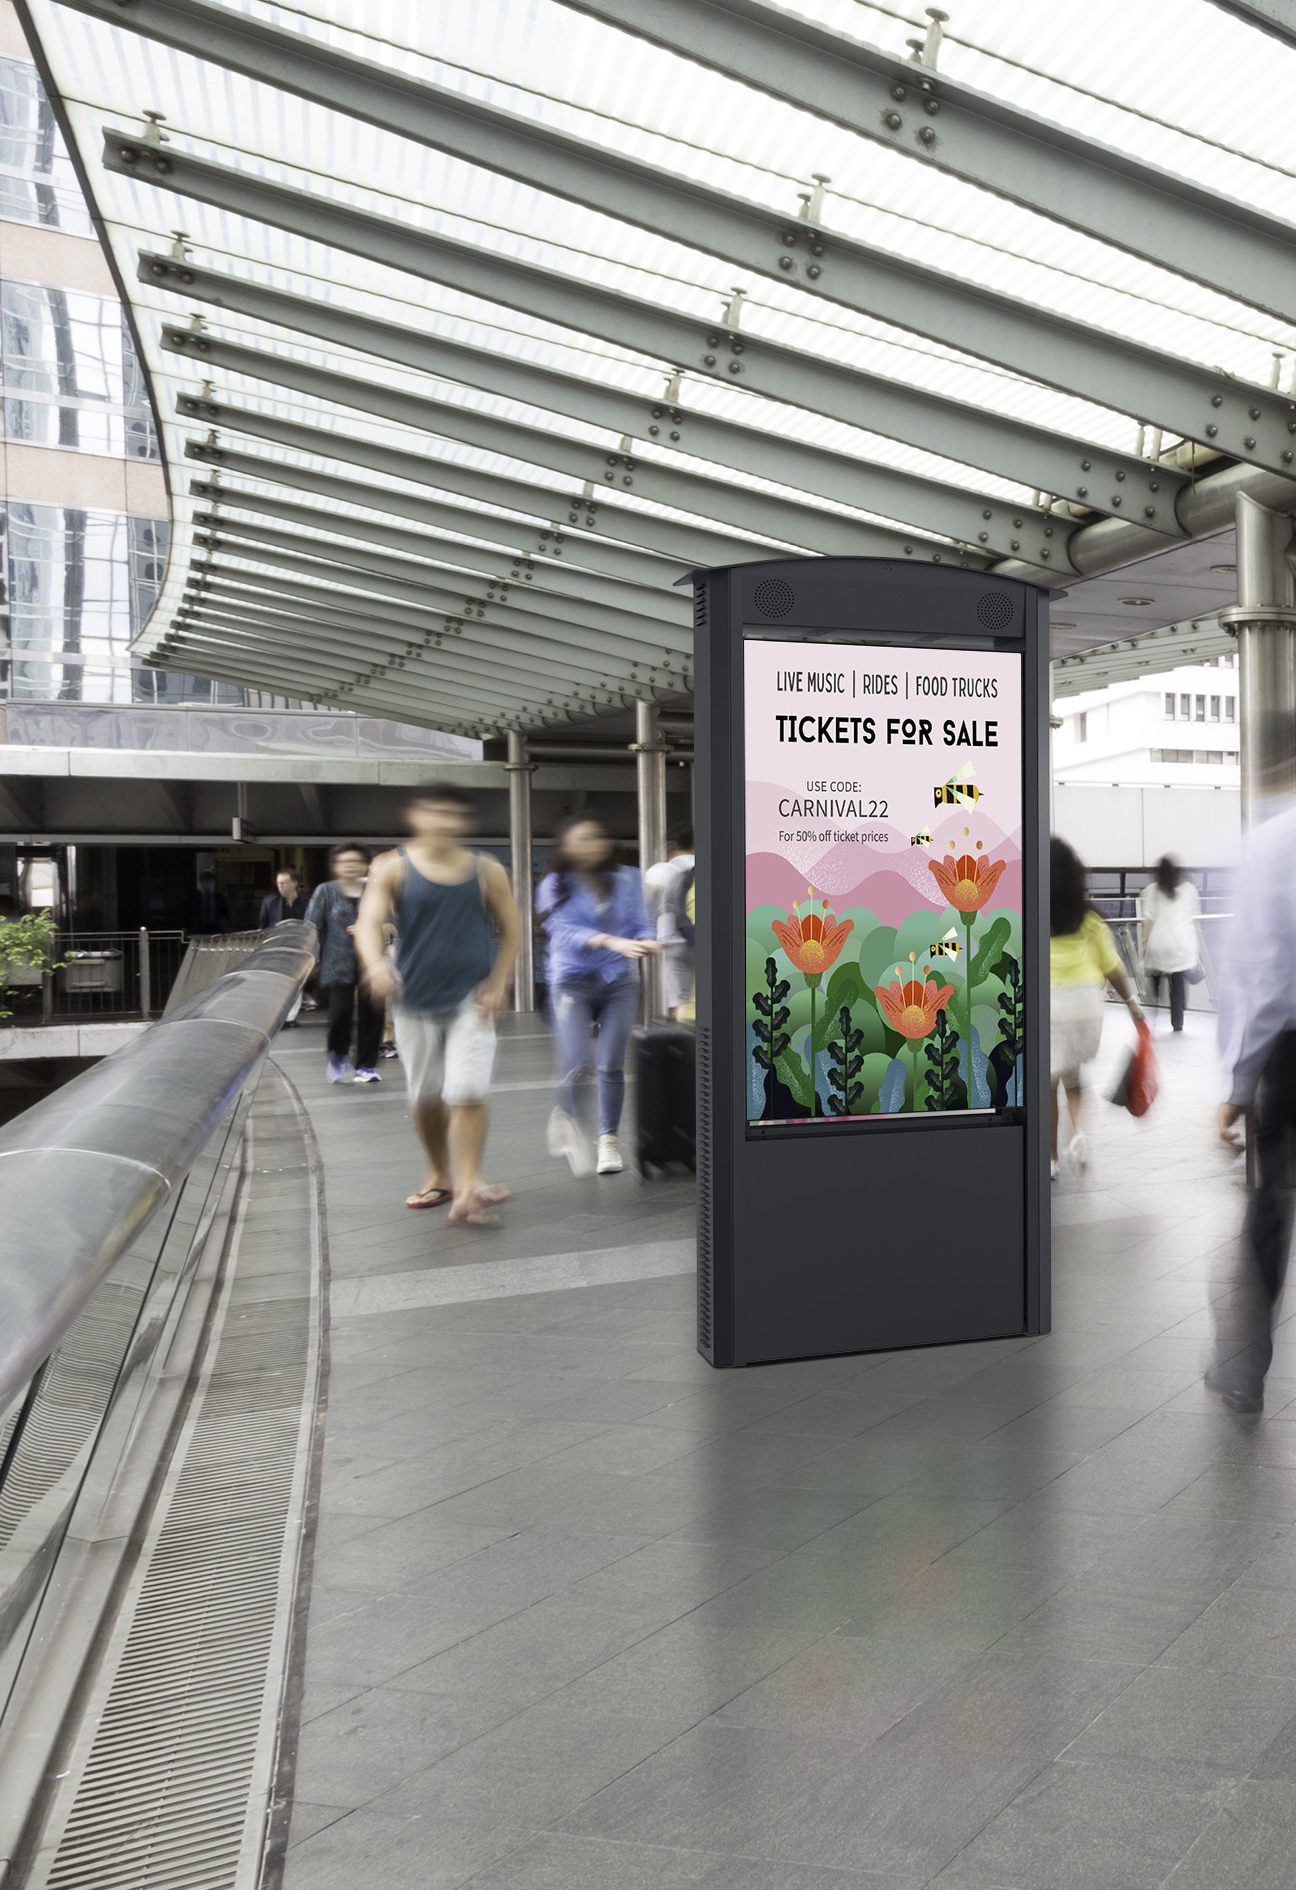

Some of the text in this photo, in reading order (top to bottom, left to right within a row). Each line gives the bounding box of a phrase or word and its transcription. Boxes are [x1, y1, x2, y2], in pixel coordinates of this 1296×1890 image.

[776, 670, 999, 699] LIVE MUSIC RIDES FOOD TRUCKS
[776, 715, 998, 747] TICKETS FOR SALE
[806, 780, 862, 793] USE CODE:
[778, 798, 889, 819] CARNIVAL22
[778, 829, 889, 845] For 50% off ticket prices
